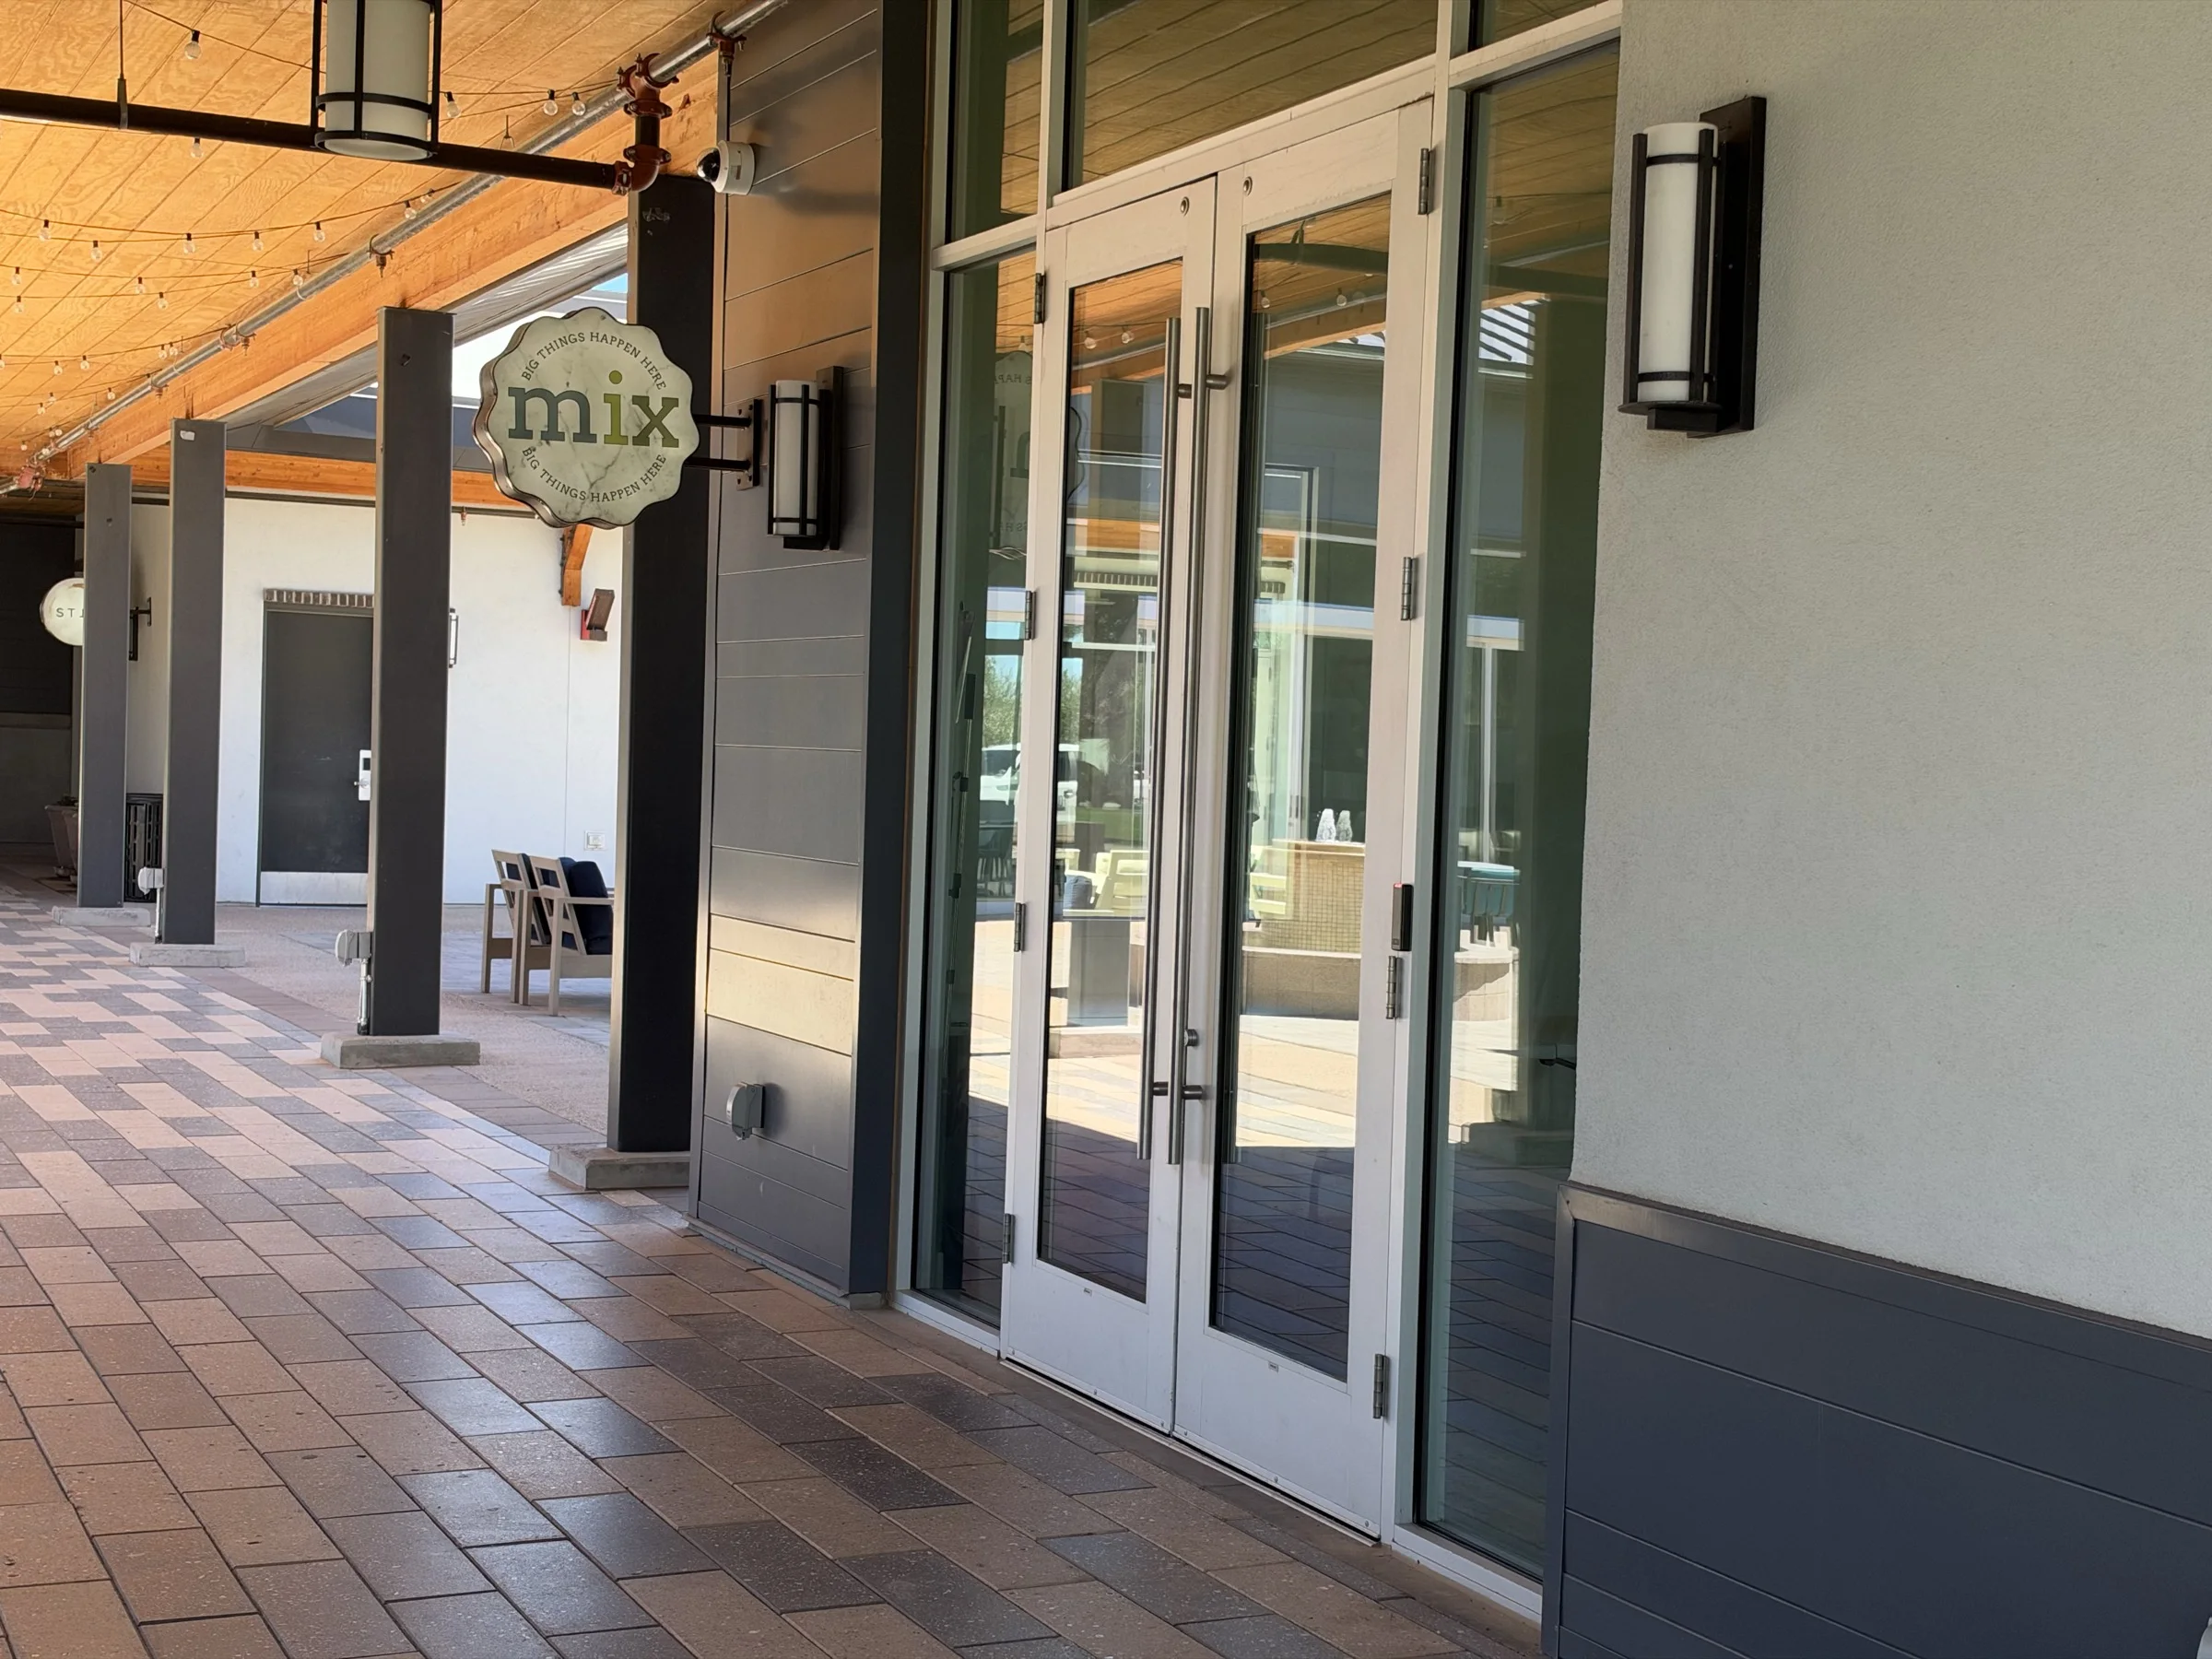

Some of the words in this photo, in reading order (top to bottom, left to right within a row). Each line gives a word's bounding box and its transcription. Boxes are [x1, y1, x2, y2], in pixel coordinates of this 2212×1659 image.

[521, 359, 540, 382] BIG
[536, 332, 585, 359] THINGS
[590, 332, 641, 359] HAPPEN
[640, 357, 667, 390] HERE
[508, 370, 679, 448] mix
[522, 447, 540, 470] BIG
[539, 468, 587, 500] THINGS
[590, 482, 641, 502] HAPPEN
[640, 454, 666, 486] HERE
